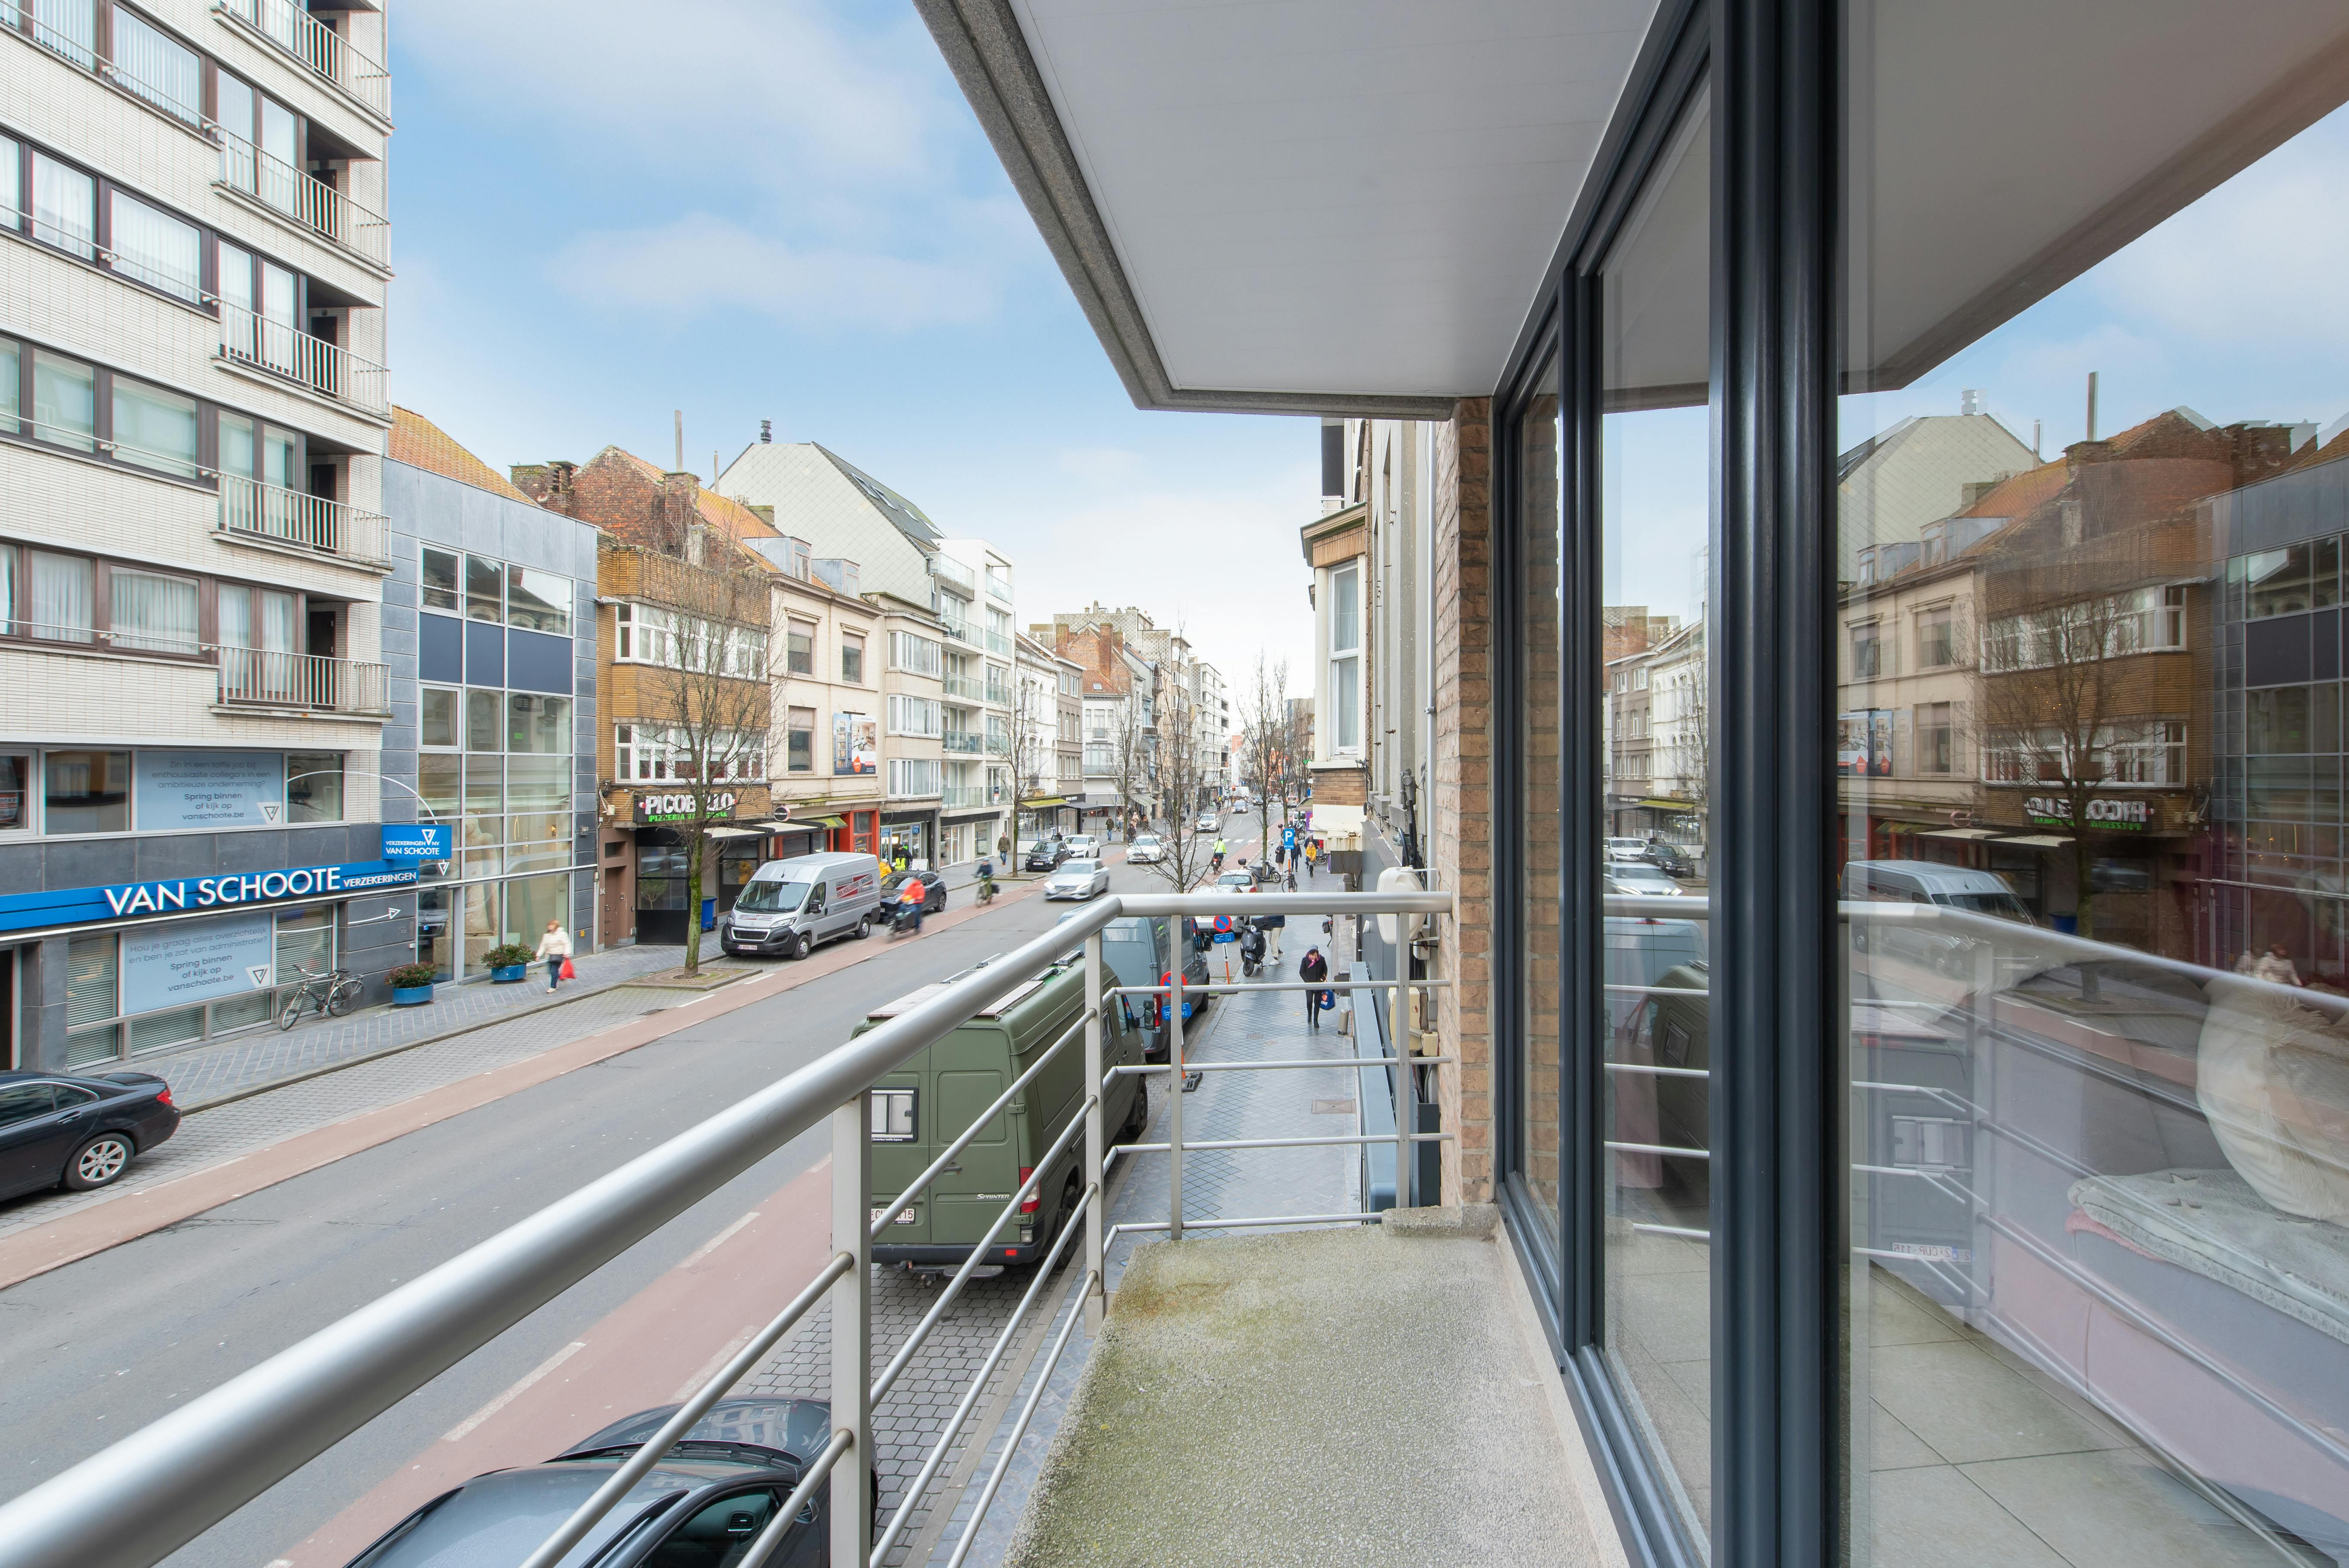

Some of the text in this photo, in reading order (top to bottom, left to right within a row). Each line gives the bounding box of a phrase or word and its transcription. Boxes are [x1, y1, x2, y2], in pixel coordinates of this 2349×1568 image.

[232, 761, 245, 770] job
[246, 761, 256, 770] bij
[206, 802, 219, 811] kijk
[182, 811, 245, 820] vanschoote.be
[1285, 831, 1292, 842] P
[104, 866, 416, 916] VAN SCHOOTE VERZEKERINGEN
[130, 927, 267, 953] Hou je graag alles overzichtelijk
[144, 952, 162, 962] ben
[164, 951, 173, 961] je
[209, 936, 268, 951] administratie?
[170, 955, 232, 971] Spring binnen
[194, 968, 208, 978] kijk
[210, 966, 222, 975] op
[168, 974, 234, 991] vanschoote.be
